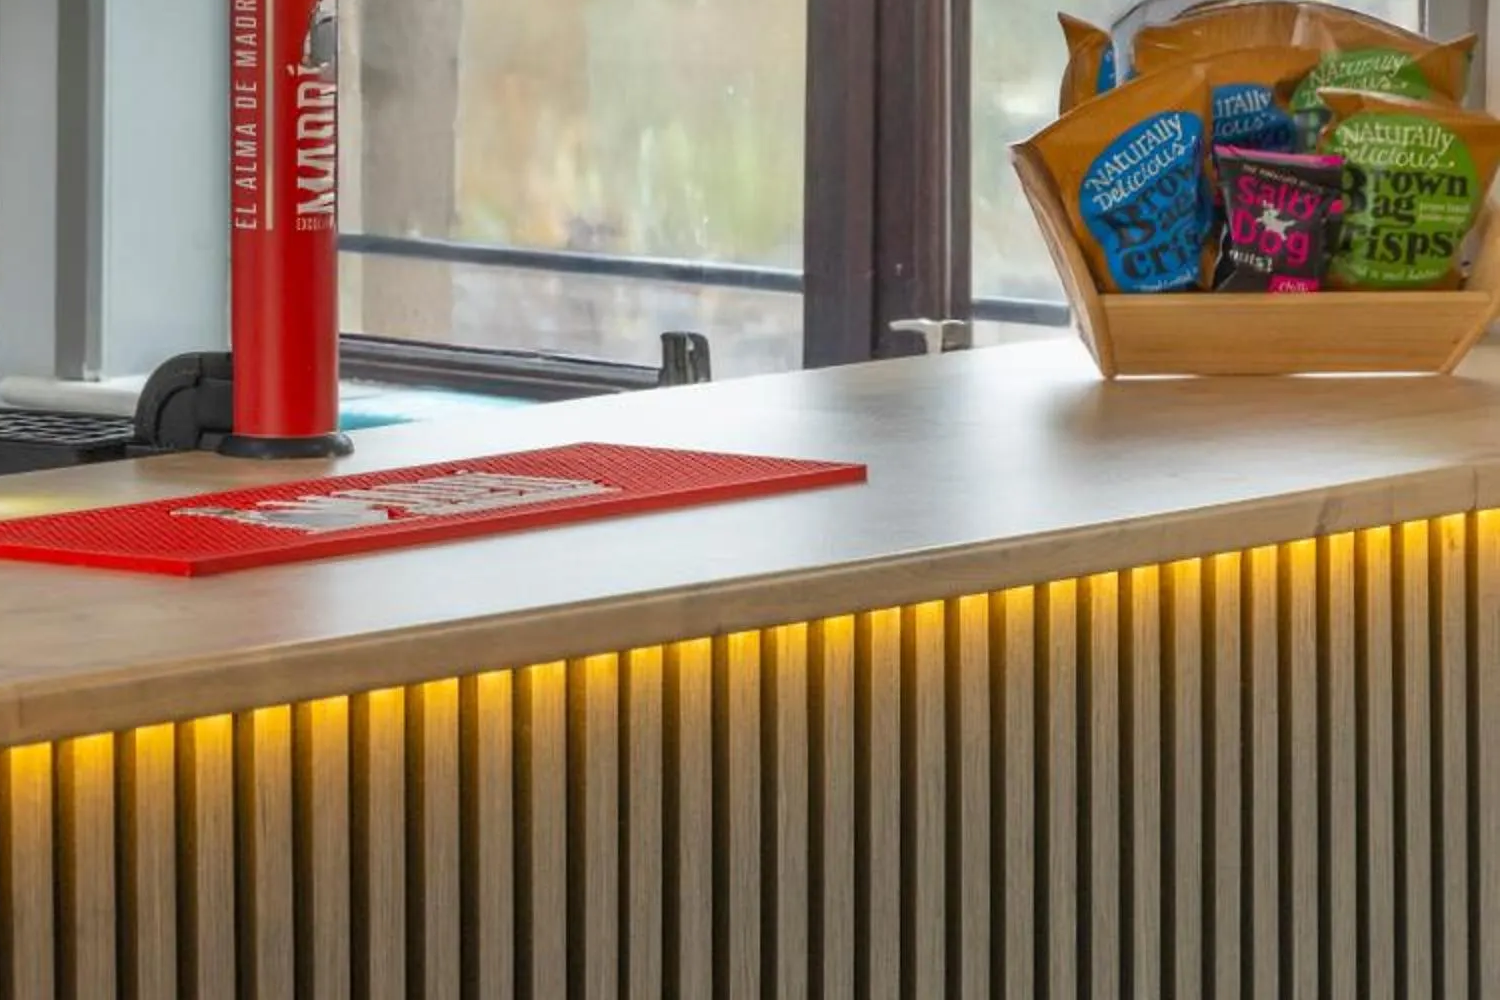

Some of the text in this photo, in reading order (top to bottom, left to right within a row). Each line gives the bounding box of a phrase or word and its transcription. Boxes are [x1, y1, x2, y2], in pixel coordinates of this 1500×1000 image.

[235, 82, 258, 110] DE
[235, 123, 258, 190] ALMA
[235, 203, 258, 230] EL
[1237, 174, 1320, 220] Salty
[1232, 207, 1311, 268] Dog
[1339, 222, 1454, 266] risps
